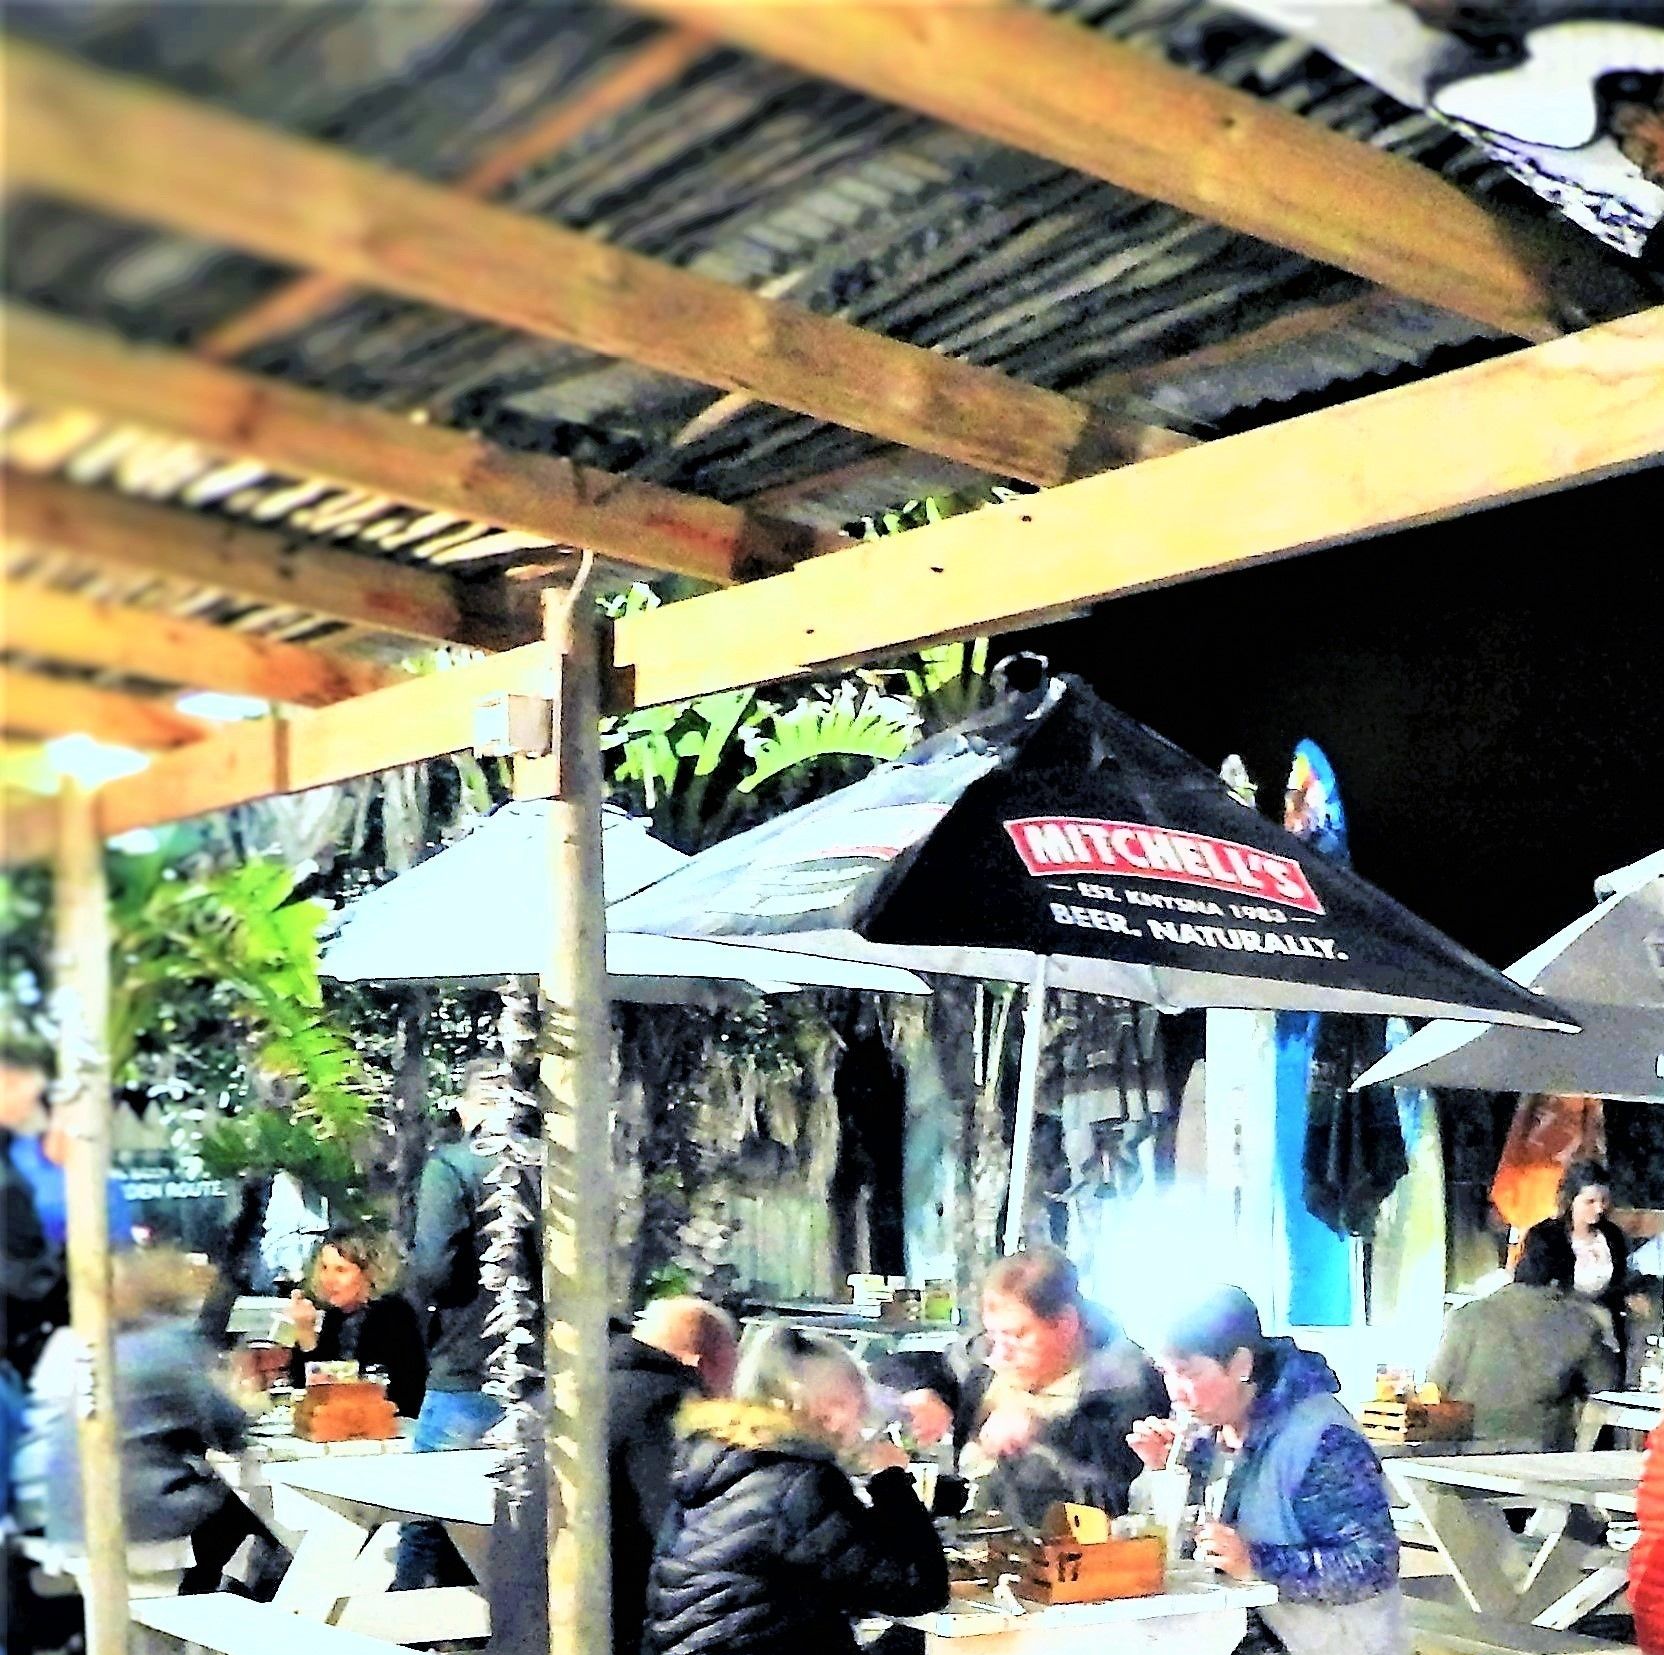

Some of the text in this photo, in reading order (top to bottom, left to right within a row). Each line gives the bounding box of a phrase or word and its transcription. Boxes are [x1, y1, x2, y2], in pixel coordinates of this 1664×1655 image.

[1023, 824, 1305, 899] MITCHELL'S
[1049, 902, 1350, 961] BEER. NATURALLY.
